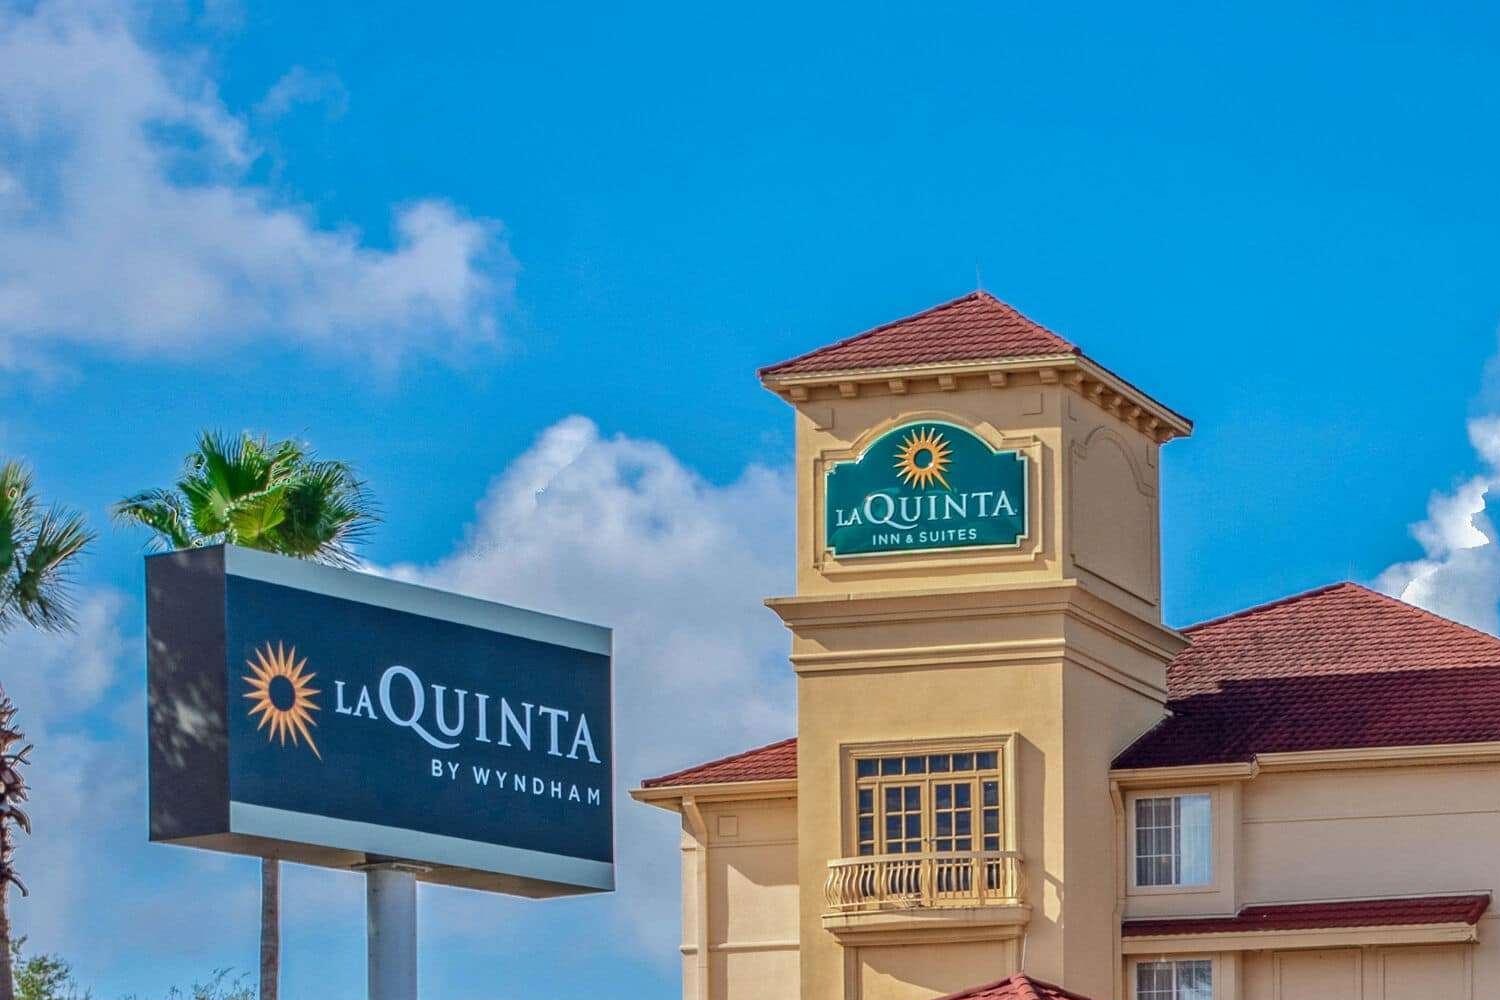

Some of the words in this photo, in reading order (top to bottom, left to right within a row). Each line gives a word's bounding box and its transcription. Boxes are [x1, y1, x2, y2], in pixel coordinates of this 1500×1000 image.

[873, 534, 900, 545] INN
[906, 534, 914, 543] &
[919, 528, 977, 543] SUITES
[431, 759, 459, 778] BY
[473, 766, 601, 806] WYNDHAM
